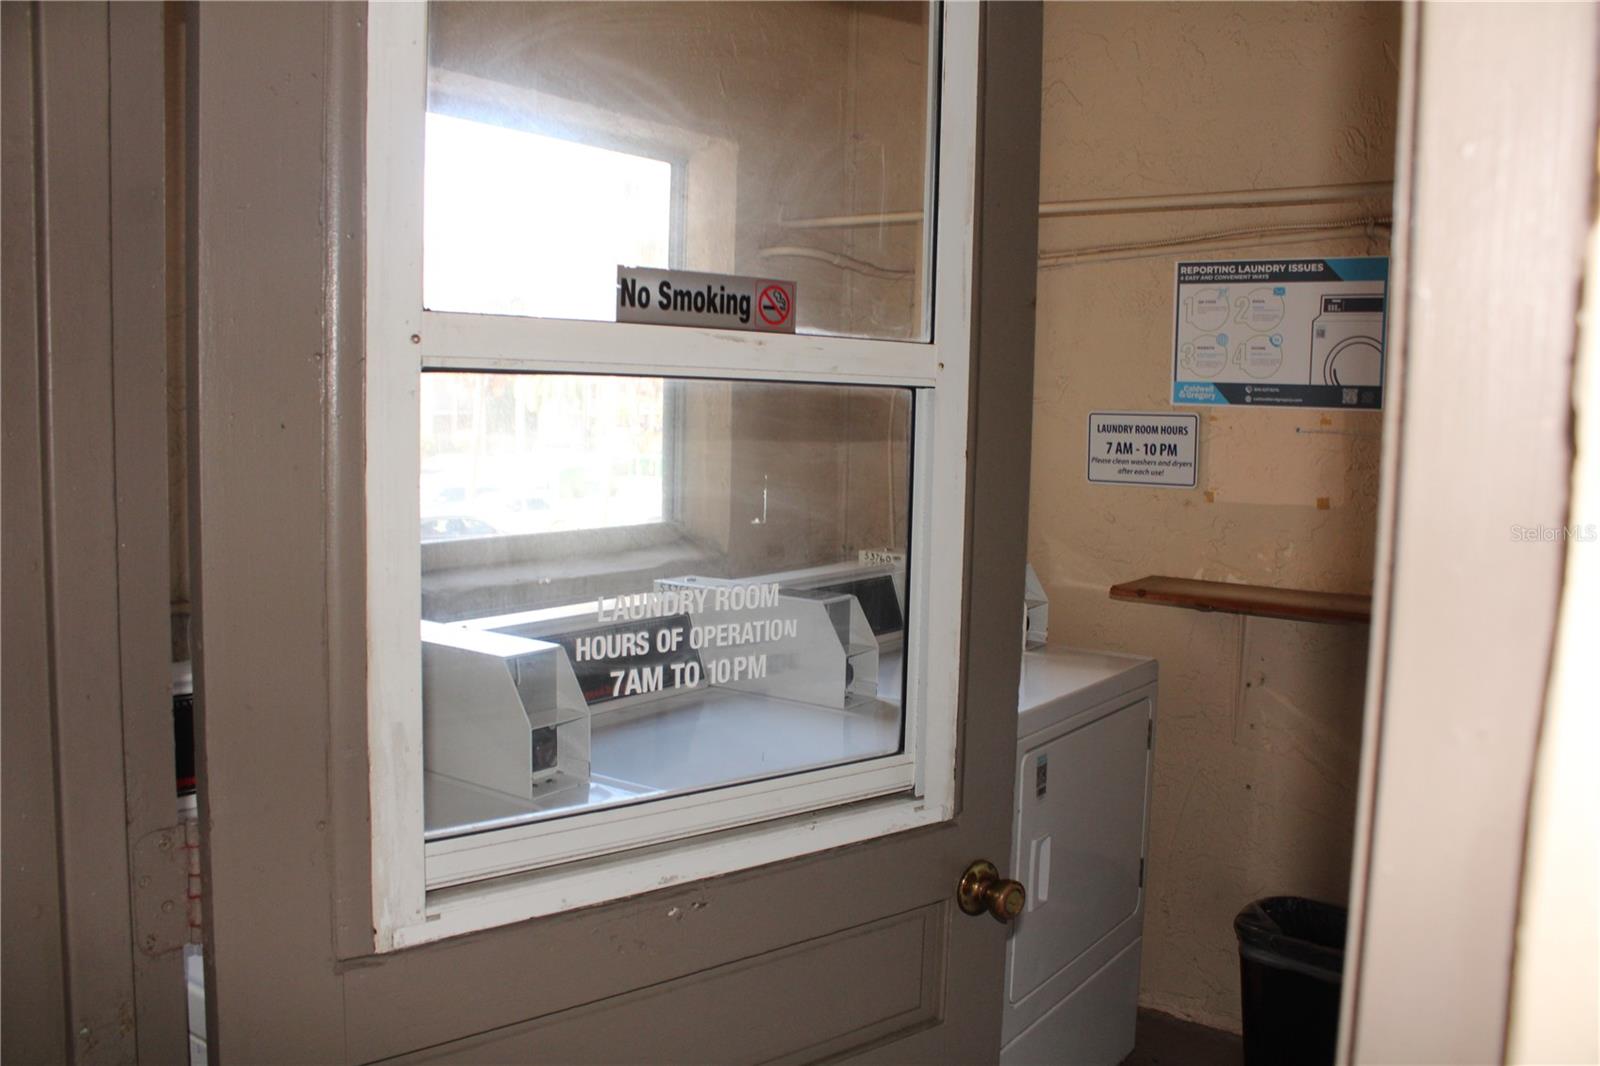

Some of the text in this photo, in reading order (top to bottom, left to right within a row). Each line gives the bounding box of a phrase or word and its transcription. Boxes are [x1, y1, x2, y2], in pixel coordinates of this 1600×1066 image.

[1180, 263, 1324, 275] REPORTING LAUNDRY ISSUES
[621, 277, 751, 324] No Smoking
[1097, 424, 1189, 436] LAUNDRY ROOM HOURS
[1106, 442, 1113, 454] 7
[1115, 442, 1133, 455] AM
[1143, 443, 1157, 456] 10
[1160, 443, 1178, 457] PM
[1091, 457, 1192, 469] Please clean washers and dryers
[1118, 467, 1134, 475] after
[597, 588, 708, 623] LAUNDRY
[715, 583, 780, 611] ROOM
[575, 618, 798, 662] HOURS OF OPERATION
[610, 665, 664, 697] 7AM
[670, 661, 700, 689] TO
